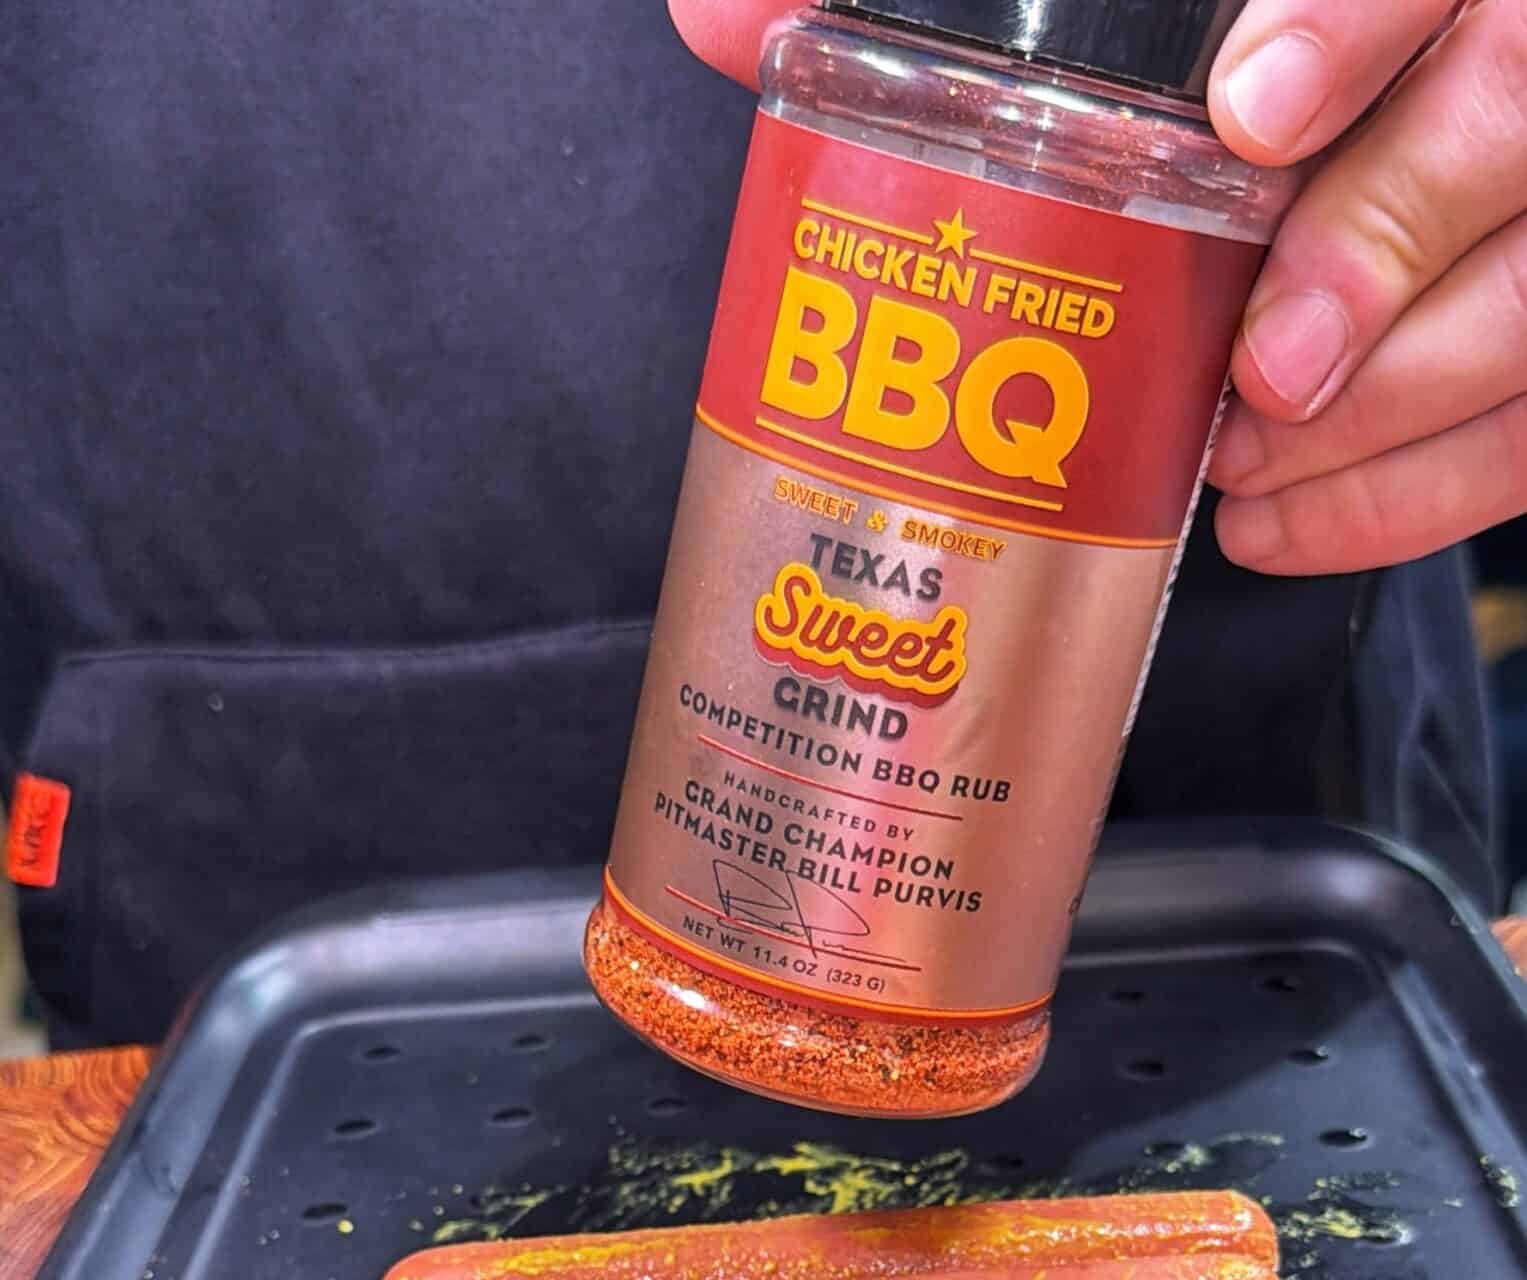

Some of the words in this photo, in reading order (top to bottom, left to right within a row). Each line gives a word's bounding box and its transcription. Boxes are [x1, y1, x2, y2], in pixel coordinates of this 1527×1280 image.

[792, 219, 975, 307] CHICKEN
[981, 273, 1116, 338] FRIED
[760, 265, 1090, 488] BBQ
[774, 477, 859, 524] SWEET
[866, 509, 888, 532] &
[901, 518, 1007, 560] SMOKEY
[809, 532, 944, 602] TEXAS
[761, 572, 960, 688] Sweet
[679, 683, 862, 774] COMPETITION
[872, 757, 940, 793] BBQ
[951, 774, 1011, 802] RUB
[773, 676, 908, 741] GRIND
[655, 792, 787, 872] PITMASTER
[799, 857, 861, 893] BILL
[873, 877, 983, 913] PURVIS
[685, 780, 773, 834] GRAND
[784, 823, 954, 880] CHAMPION
[724, 771, 876, 833] HANDCRAFTED
[887, 824, 914, 841] BY
[683, 915, 714, 940] NET
[720, 933, 747, 953] WT
[753, 946, 788, 967] 11.4
[793, 960, 818, 976] OZ
[826, 967, 862, 987] (323
[867, 976, 885, 993] G)
